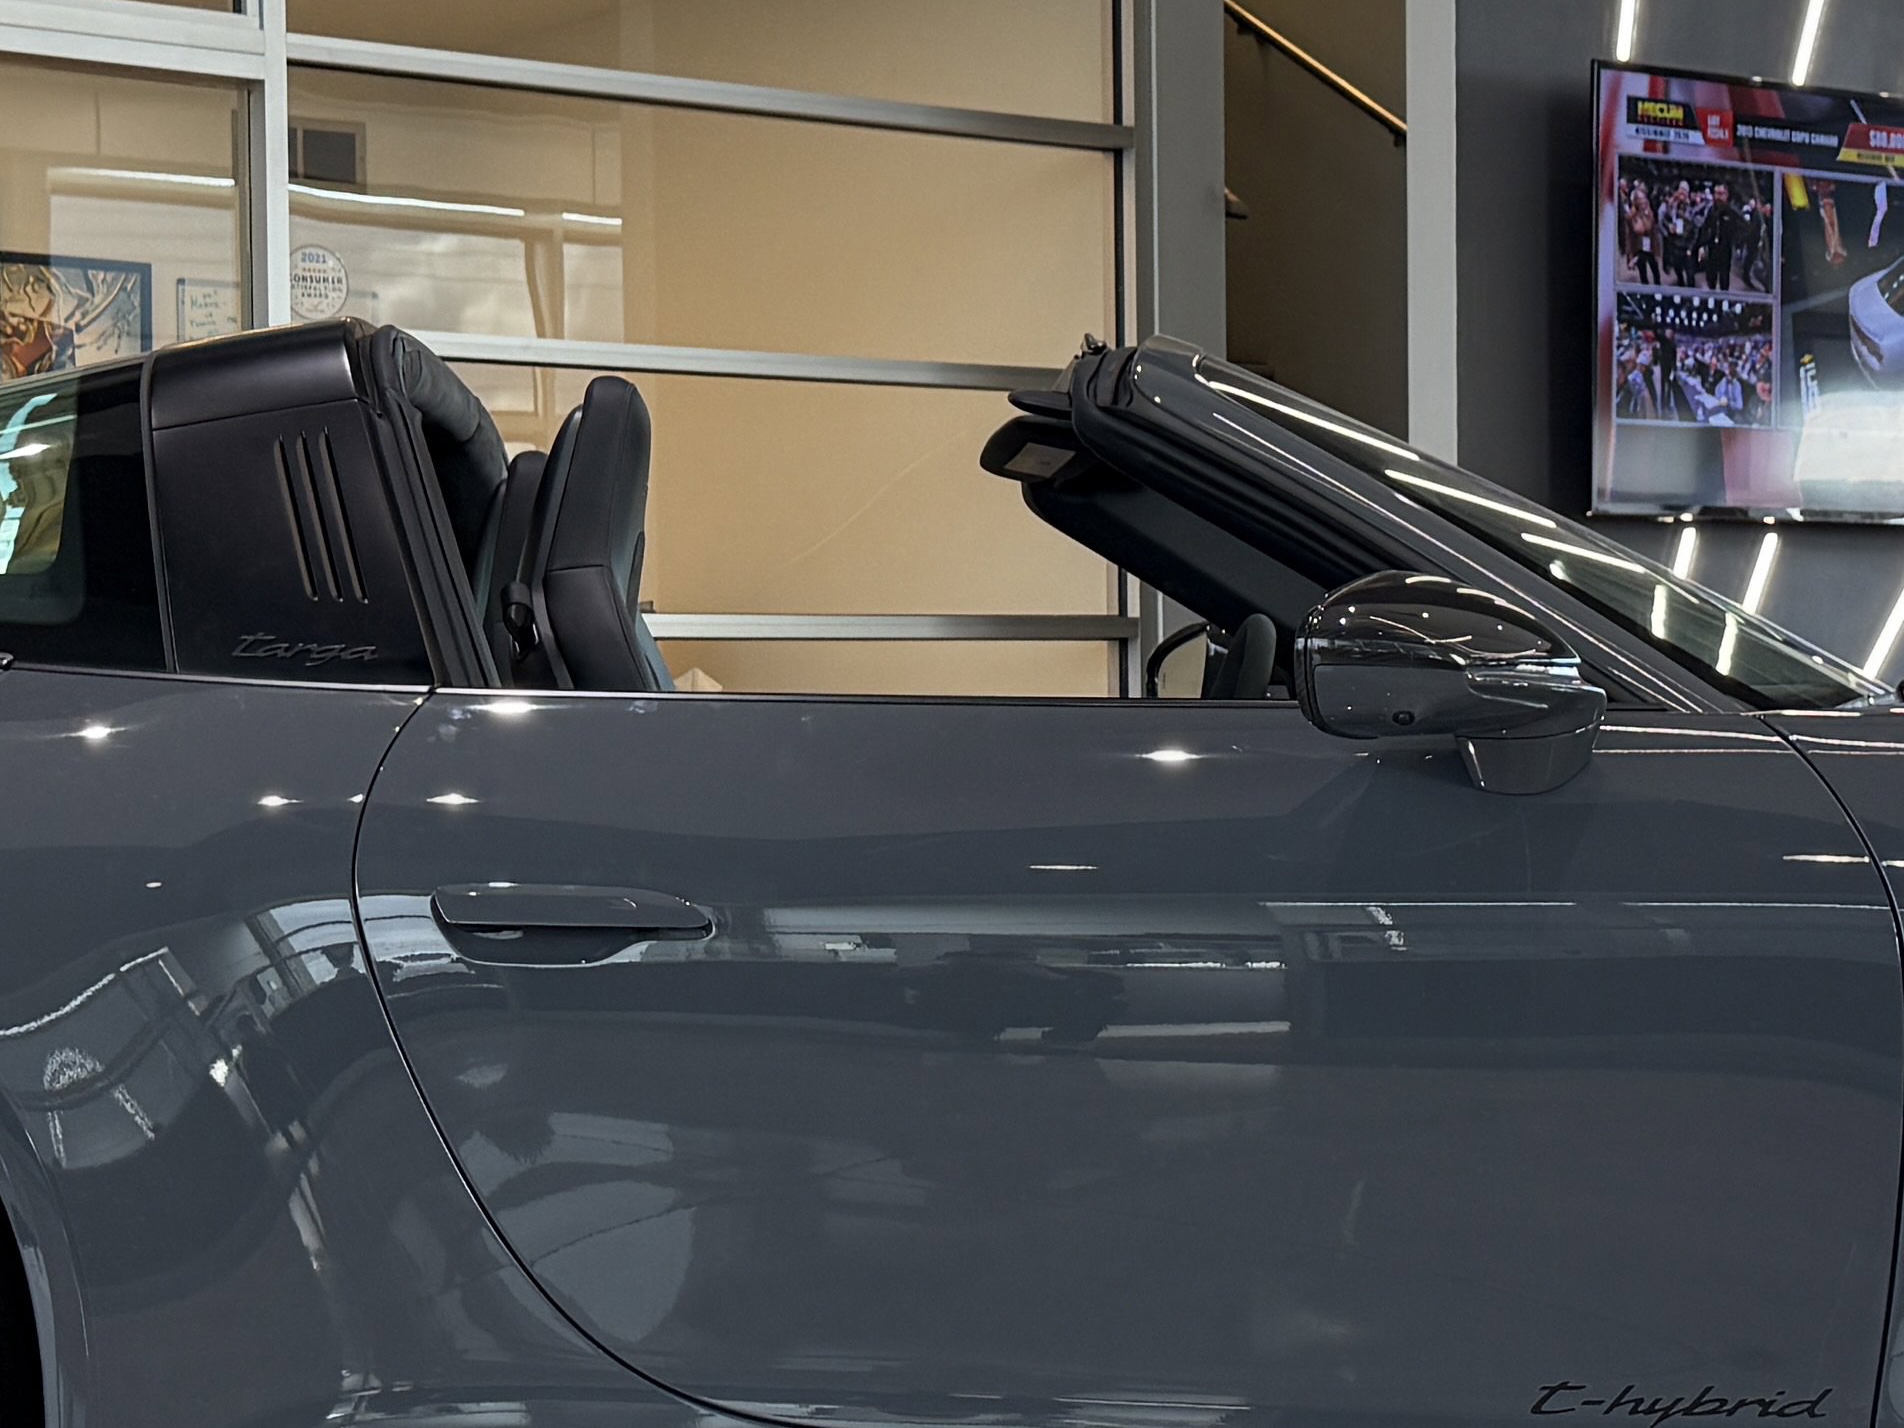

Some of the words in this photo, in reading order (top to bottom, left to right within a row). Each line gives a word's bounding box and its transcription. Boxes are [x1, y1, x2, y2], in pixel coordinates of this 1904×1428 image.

[301, 253, 327, 264] 2021
[291, 274, 343, 285] ONSUMER
[232, 631, 379, 666] targa
